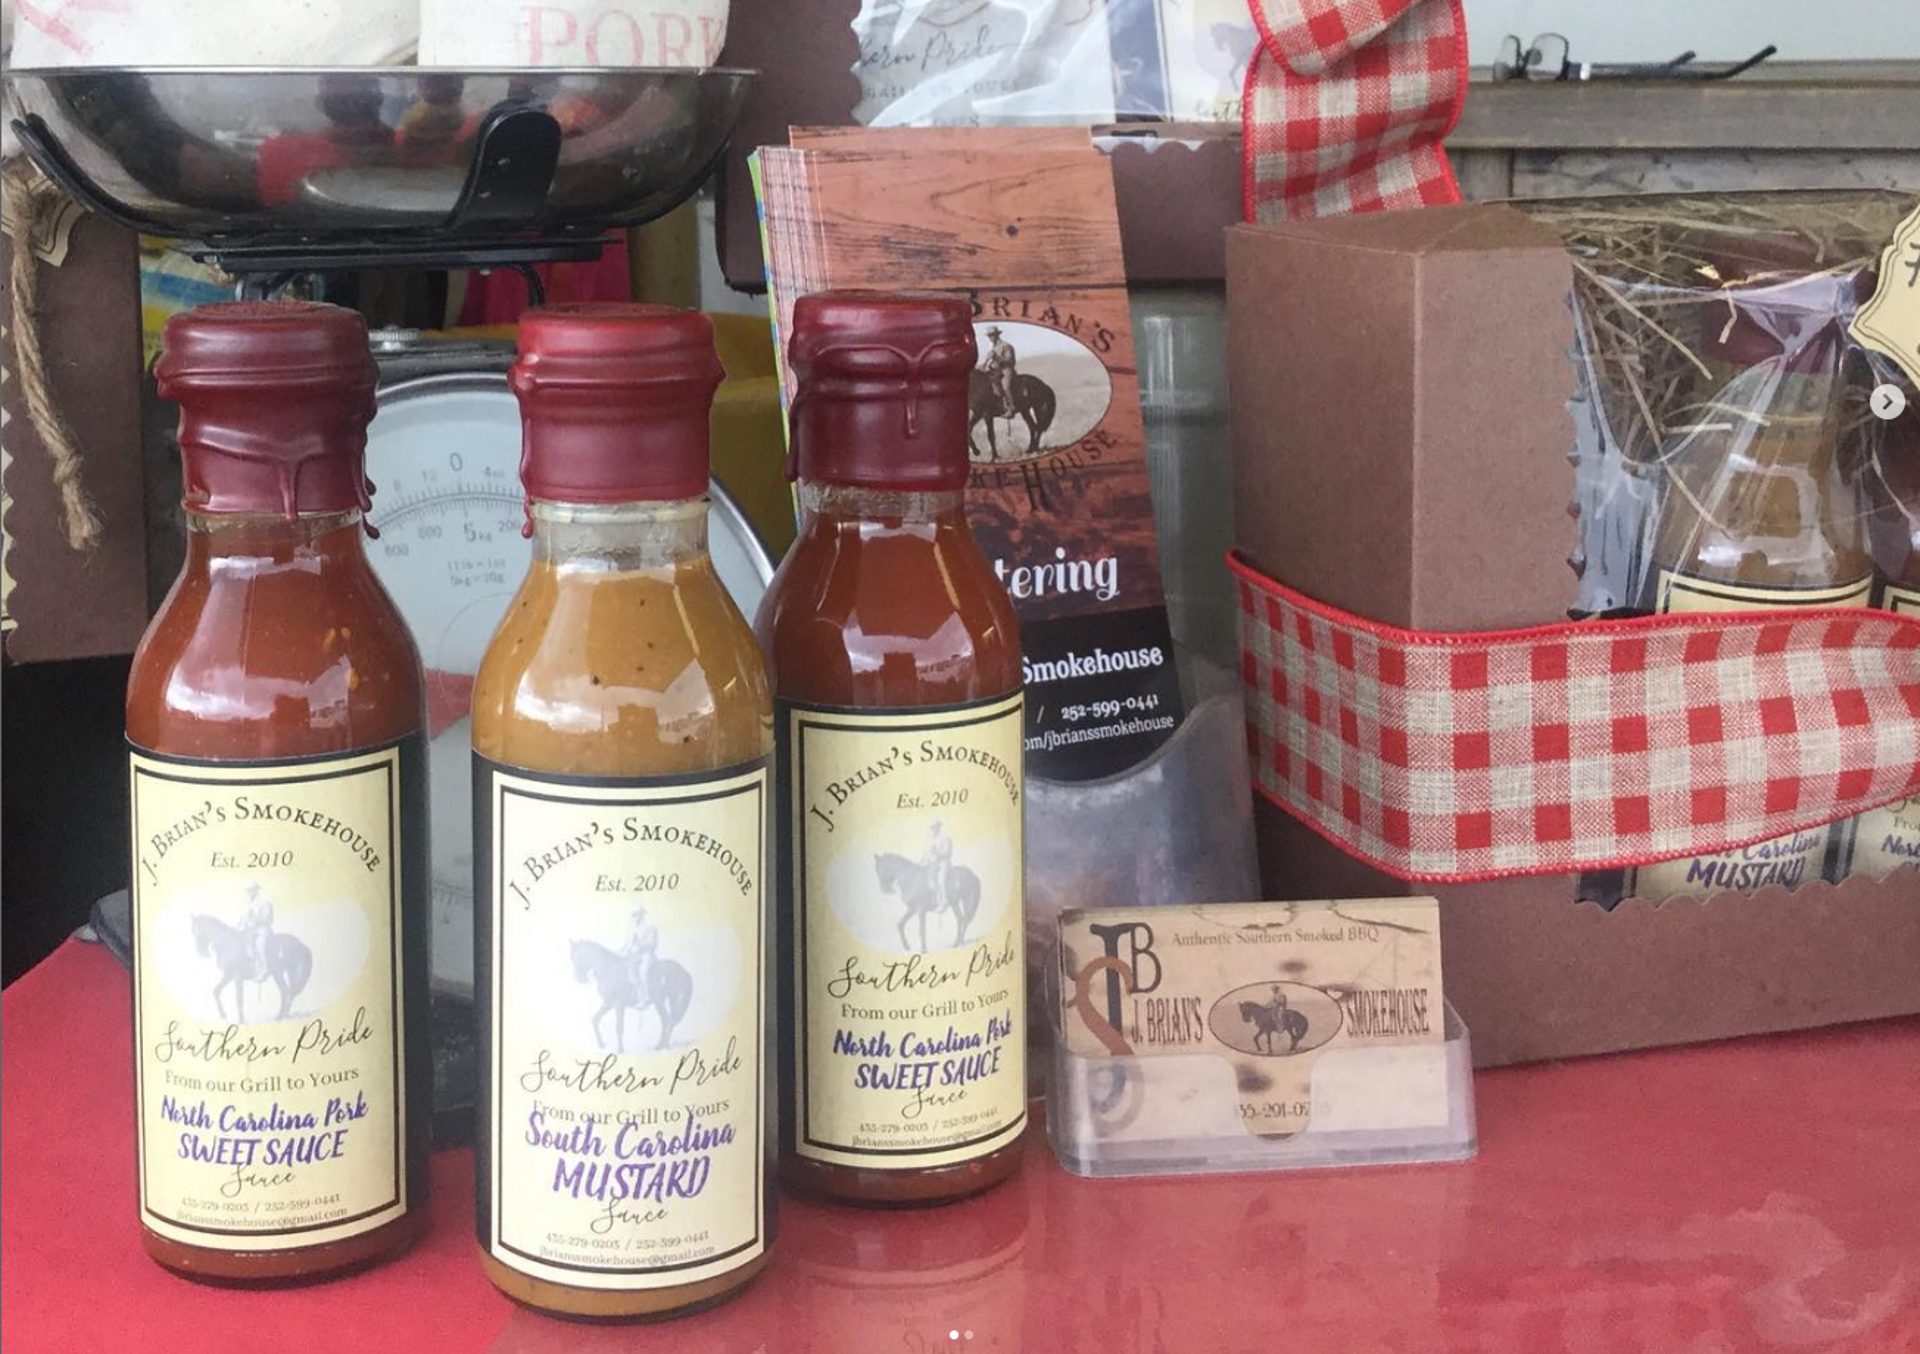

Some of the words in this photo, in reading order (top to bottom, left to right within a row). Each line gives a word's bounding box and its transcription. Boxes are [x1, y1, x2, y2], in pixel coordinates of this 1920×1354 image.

[522, 5, 724, 68] PORK
[449, 452, 464, 472] 0
[1023, 645, 1164, 685] Smokehouse
[1061, 694, 1160, 722] 252-599-0441
[896, 793, 925, 810] Est.
[931, 788, 969, 808] 2010
[810, 803, 835, 832] J.
[141, 856, 159, 887] J.
[211, 851, 241, 868] Est.
[247, 850, 295, 868] 2010
[509, 880, 531, 910] J.
[595, 874, 627, 892] Est.
[633, 873, 680, 892] 2010
[1172, 932, 1232, 946] Authentic
[1236, 929, 1292, 944] Southern
[1295, 928, 1344, 942] Smoked
[1348, 927, 1380, 942] BBQ
[828, 954, 960, 998] Southern
[966, 930, 1015, 988] Pride
[841, 1003, 885, 1021] From
[888, 1007, 918, 1021] our
[922, 1001, 958, 1019] Grill
[961, 999, 975, 1013] to
[976, 988, 1010, 1010] Yours
[1146, 997, 1204, 1045] BRIAN'S
[1345, 987, 1431, 1039] SMOKEHOUSE
[155, 1020, 286, 1063] Southern
[292, 1006, 374, 1063] Pride
[833, 1029, 895, 1058] North
[899, 1026, 983, 1058] Carolina
[986, 1010, 1013, 1043] Pork
[165, 1070, 203, 1092] From
[206, 1077, 236, 1093] our
[240, 1074, 282, 1093] Grill
[287, 1074, 304, 1090] to
[309, 1067, 360, 1088] Yours
[520, 1050, 665, 1093] Southern
[669, 1035, 742, 1095] Pride
[854, 1061, 940, 1090] SWEET
[940, 1046, 1002, 1087] SAUCE
[161, 1094, 214, 1129] North
[219, 1103, 319, 1132] Carolina
[323, 1089, 370, 1127] Pork
[533, 1099, 576, 1122] From
[580, 1110, 613, 1126] our
[616, 1107, 659, 1126] Grill
[663, 1107, 681, 1122] to
[685, 1099, 730, 1119] Yours
[901, 1087, 968, 1119] Sauce
[177, 1131, 262, 1167] SWEET
[262, 1128, 349, 1168] SAUCE
[525, 1109, 607, 1157] South
[614, 1114, 736, 1160] Carolina
[220, 1163, 296, 1198] Sauce
[552, 1155, 711, 1203] MUSTARD
[590, 1197, 668, 1234] Sauce
